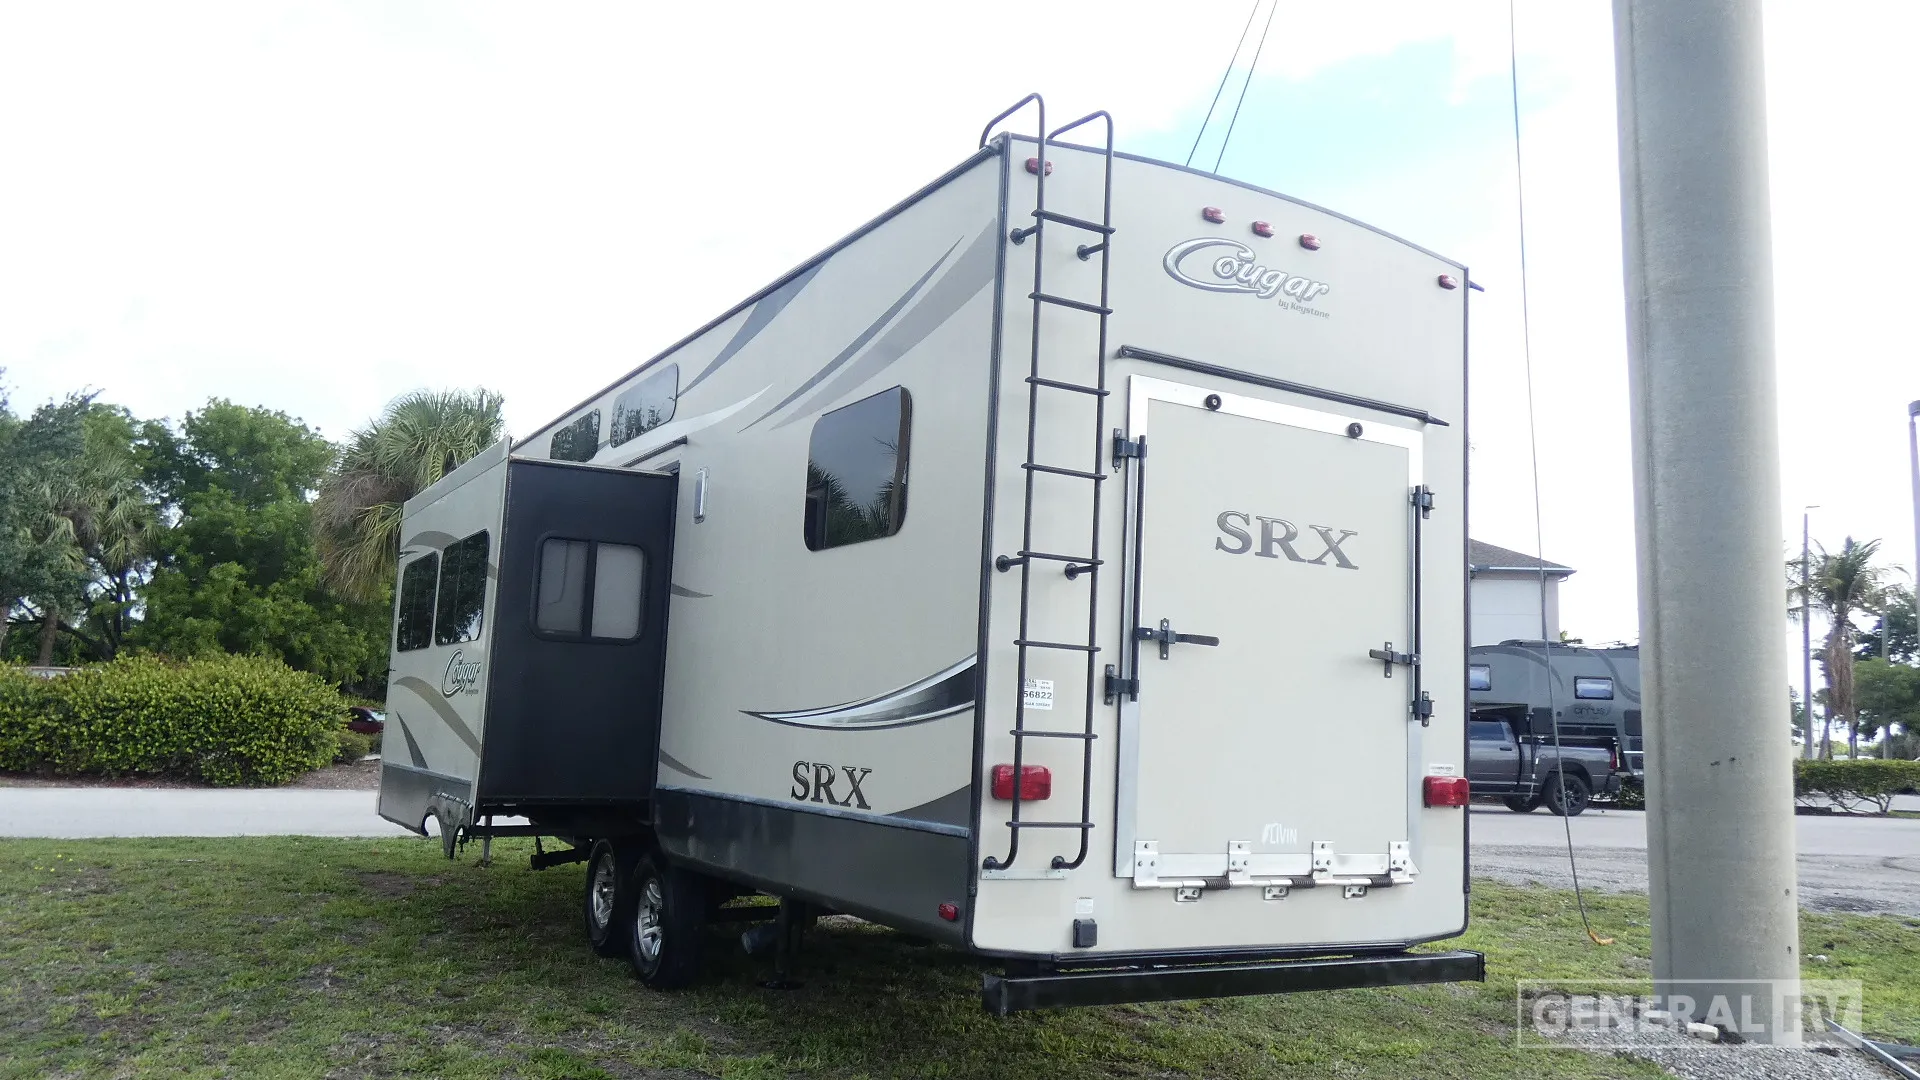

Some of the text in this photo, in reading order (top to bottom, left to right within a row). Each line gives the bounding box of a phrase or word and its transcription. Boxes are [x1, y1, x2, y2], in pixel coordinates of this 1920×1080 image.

[1162, 236, 1330, 302] Cougar
[1278, 298, 1330, 318] by Keystone
[1215, 510, 1359, 570] SRX
[442, 649, 481, 698] Cougar
[790, 760, 872, 810] SRX
